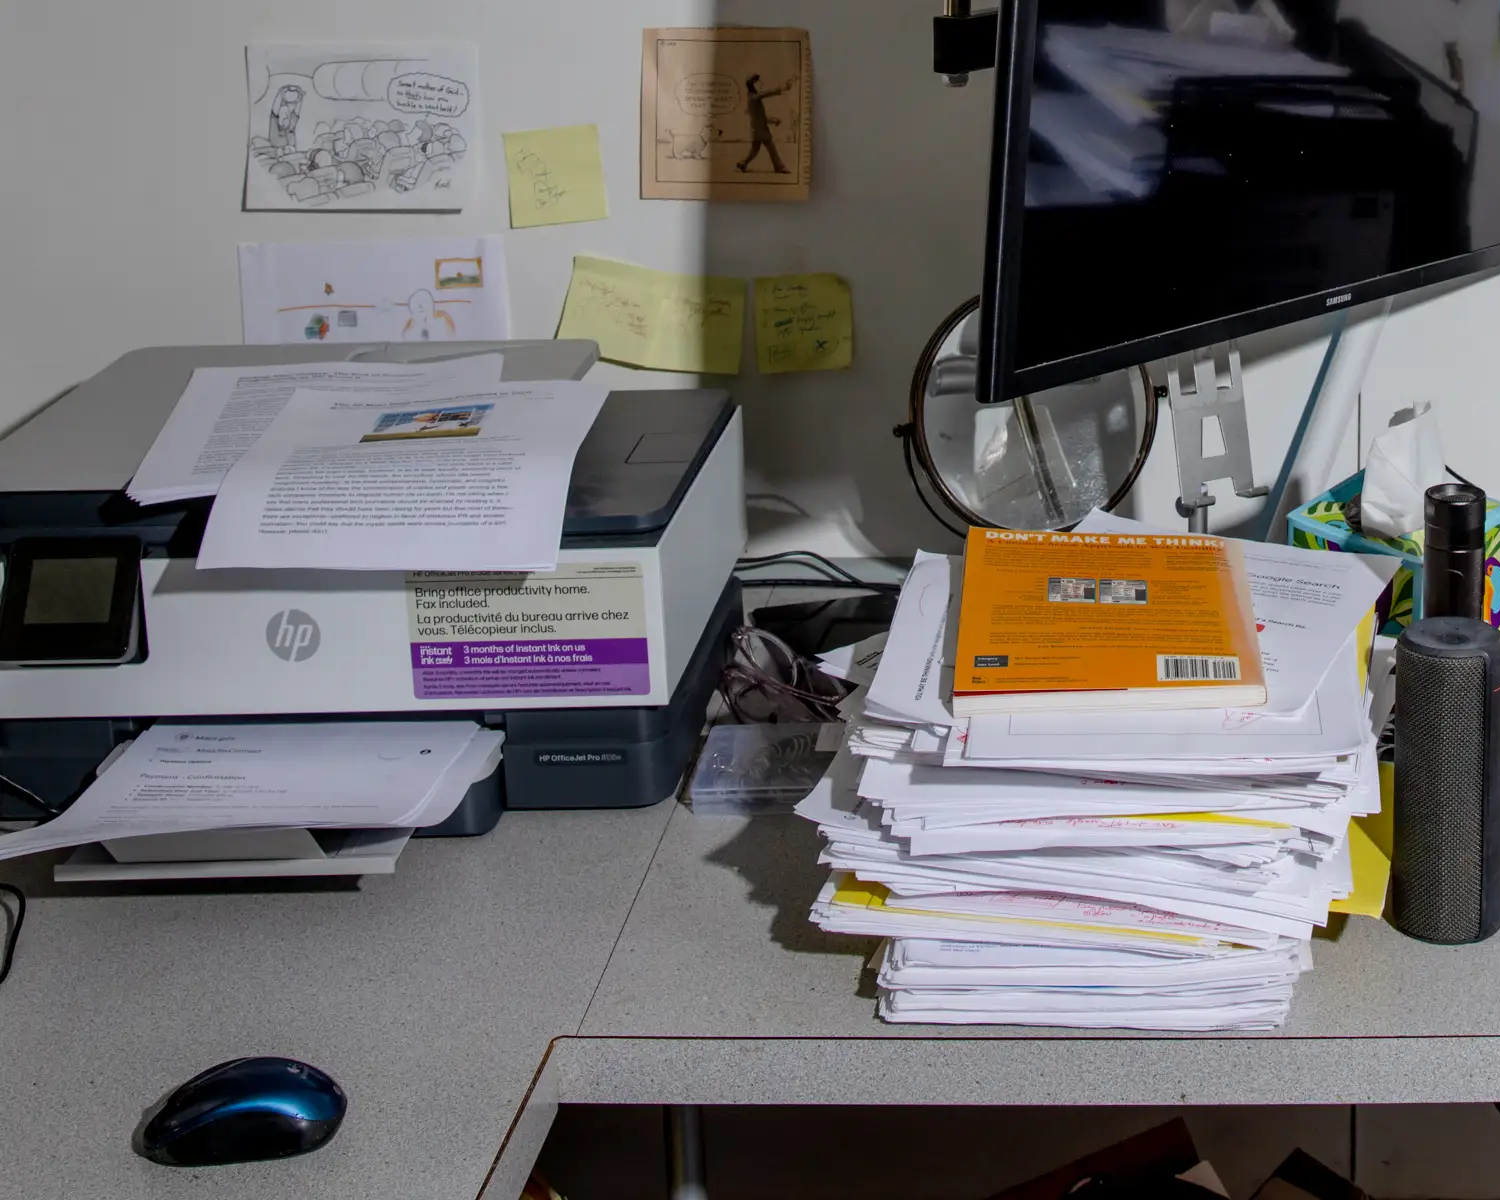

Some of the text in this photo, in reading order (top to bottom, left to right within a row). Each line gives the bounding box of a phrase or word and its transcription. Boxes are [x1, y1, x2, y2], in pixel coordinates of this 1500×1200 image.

[985, 531, 1225, 549] DON'T MAKE ME THINK!
[1296, 579, 1340, 590] Search
[415, 584, 591, 599] Bring office productivity home.
[416, 598, 490, 609] Fax included.
[417, 610, 629, 627] La productivité du bureau arrive chez
[273, 609, 314, 663] hp
[418, 623, 557, 638] vous. Télécopieur inclus.
[420, 645, 452, 656] instant
[463, 645, 469, 654] 3
[470, 645, 504, 654] months
[505, 644, 515, 653] of
[515, 643, 546, 653] Instant
[548, 643, 560, 652] Ink
[421, 656, 435, 665] ink
[463, 656, 470, 665] 3
[471, 655, 493, 664] mois
[494, 654, 532, 664] d'Instant
[534, 654, 546, 663] Ink
[547, 654, 554, 662] à
[572, 653, 593, 662] frais
[539, 754, 550, 762] HP
[550, 754, 586, 762] OfficeJet
[140, 773, 246, 781] Payment Confirmation
